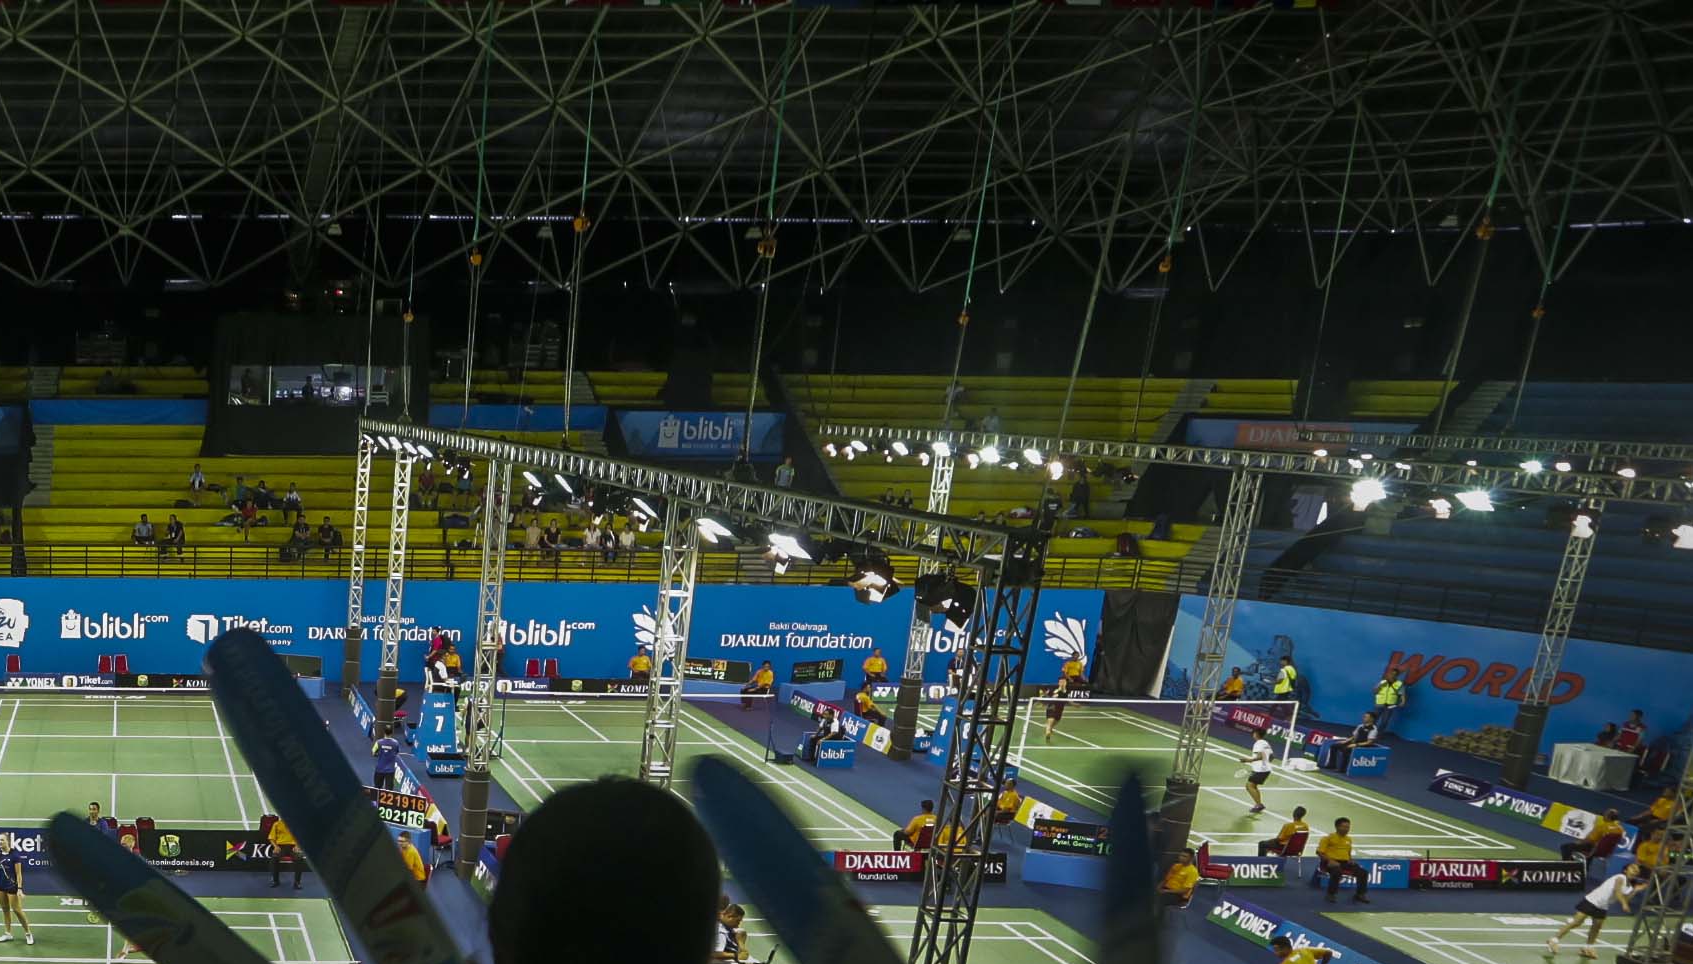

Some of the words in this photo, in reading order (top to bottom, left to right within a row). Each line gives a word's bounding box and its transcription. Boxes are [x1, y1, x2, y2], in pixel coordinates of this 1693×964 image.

[308, 627, 368, 641] DJARM
[769, 622, 790, 631] Bakti
[792, 622, 828, 632] Olahraga
[720, 634, 780, 648] DJARUM
[785, 632, 873, 649] foundation
[25, 677, 56, 688] YONEX
[1385, 651, 1586, 704] WORLD
[620, 684, 648, 694] KOMP
[435, 716, 444, 732] 7
[379, 791, 394, 806] 22
[395, 794, 410, 809] 19
[410, 798, 425, 811] 16
[1508, 797, 1547, 819] YONEX
[378, 806, 393, 820] 20
[392, 809, 407, 824] 21
[409, 814, 423, 826] 16
[845, 854, 911, 870] DJARUM
[857, 873, 898, 881] foundation
[1231, 863, 1279, 879] YONEX
[1419, 862, 1487, 879] DJARUM
[1521, 869, 1582, 884] KOMPAS
[1432, 880, 1474, 889] foundation
[1235, 908, 1278, 941] YONEX
